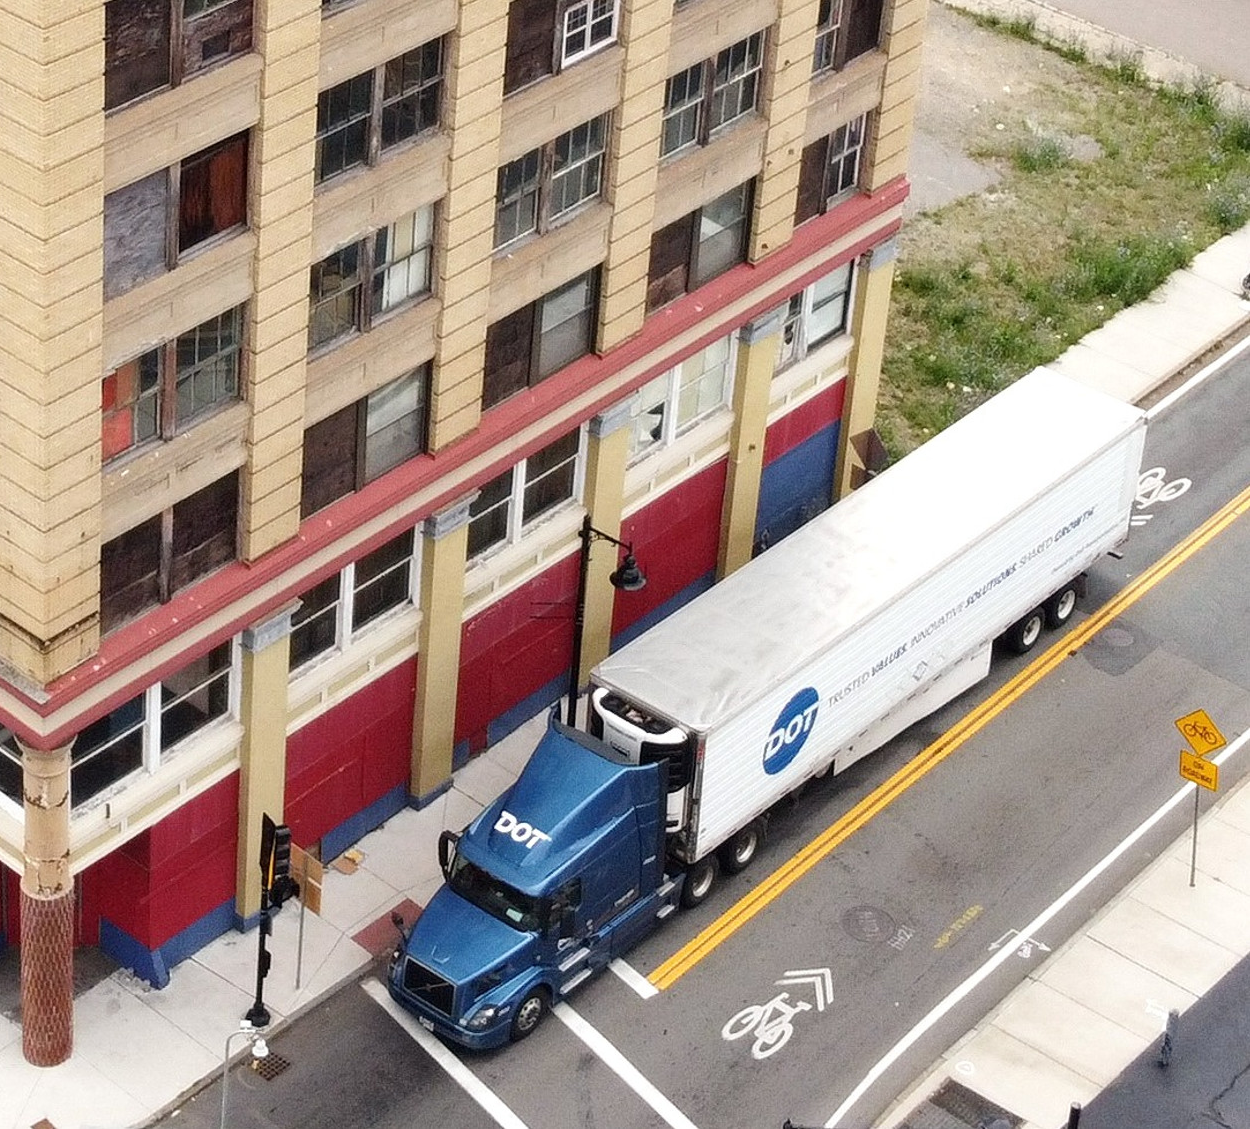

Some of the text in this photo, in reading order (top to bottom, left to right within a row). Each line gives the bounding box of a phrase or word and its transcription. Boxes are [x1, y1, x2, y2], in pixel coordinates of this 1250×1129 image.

[828, 672, 870, 707] TRUSTED
[871, 642, 907, 677] VALUES
[964, 562, 1017, 608] SOLUTIONS
[1018, 537, 1053, 569] SHARED
[1053, 503, 1098, 542] GROWTH
[764, 701, 820, 761] DOT
[493, 810, 553, 849] DOT
